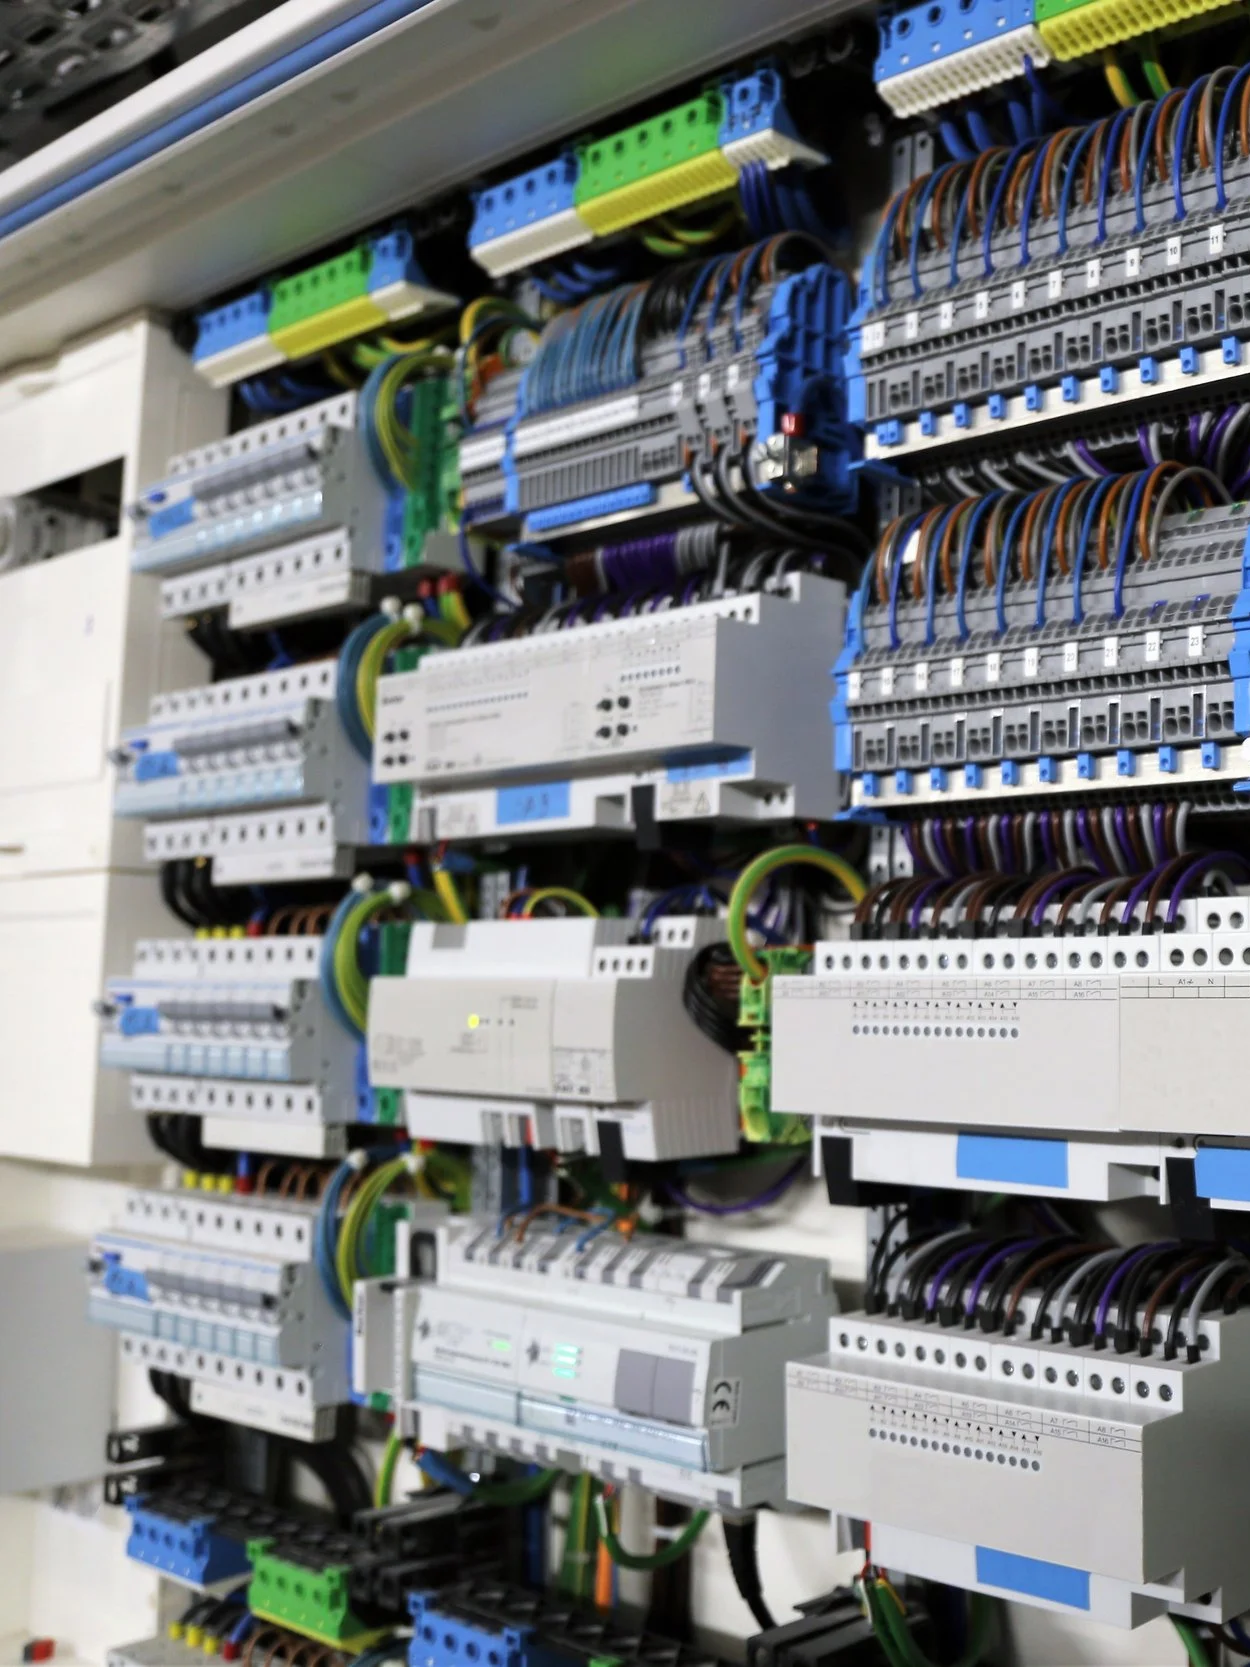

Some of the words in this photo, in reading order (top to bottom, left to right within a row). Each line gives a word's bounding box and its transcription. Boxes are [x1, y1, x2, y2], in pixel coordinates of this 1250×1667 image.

[1211, 235, 1219, 245] 11
[1169, 247, 1178, 256] 10
[1148, 642, 1157, 652] 22
[1190, 637, 1200, 647] 23
[1066, 652, 1076, 662] 20
[1105, 647, 1114, 657] 21
[1097, 1426, 1106, 1434] A8
